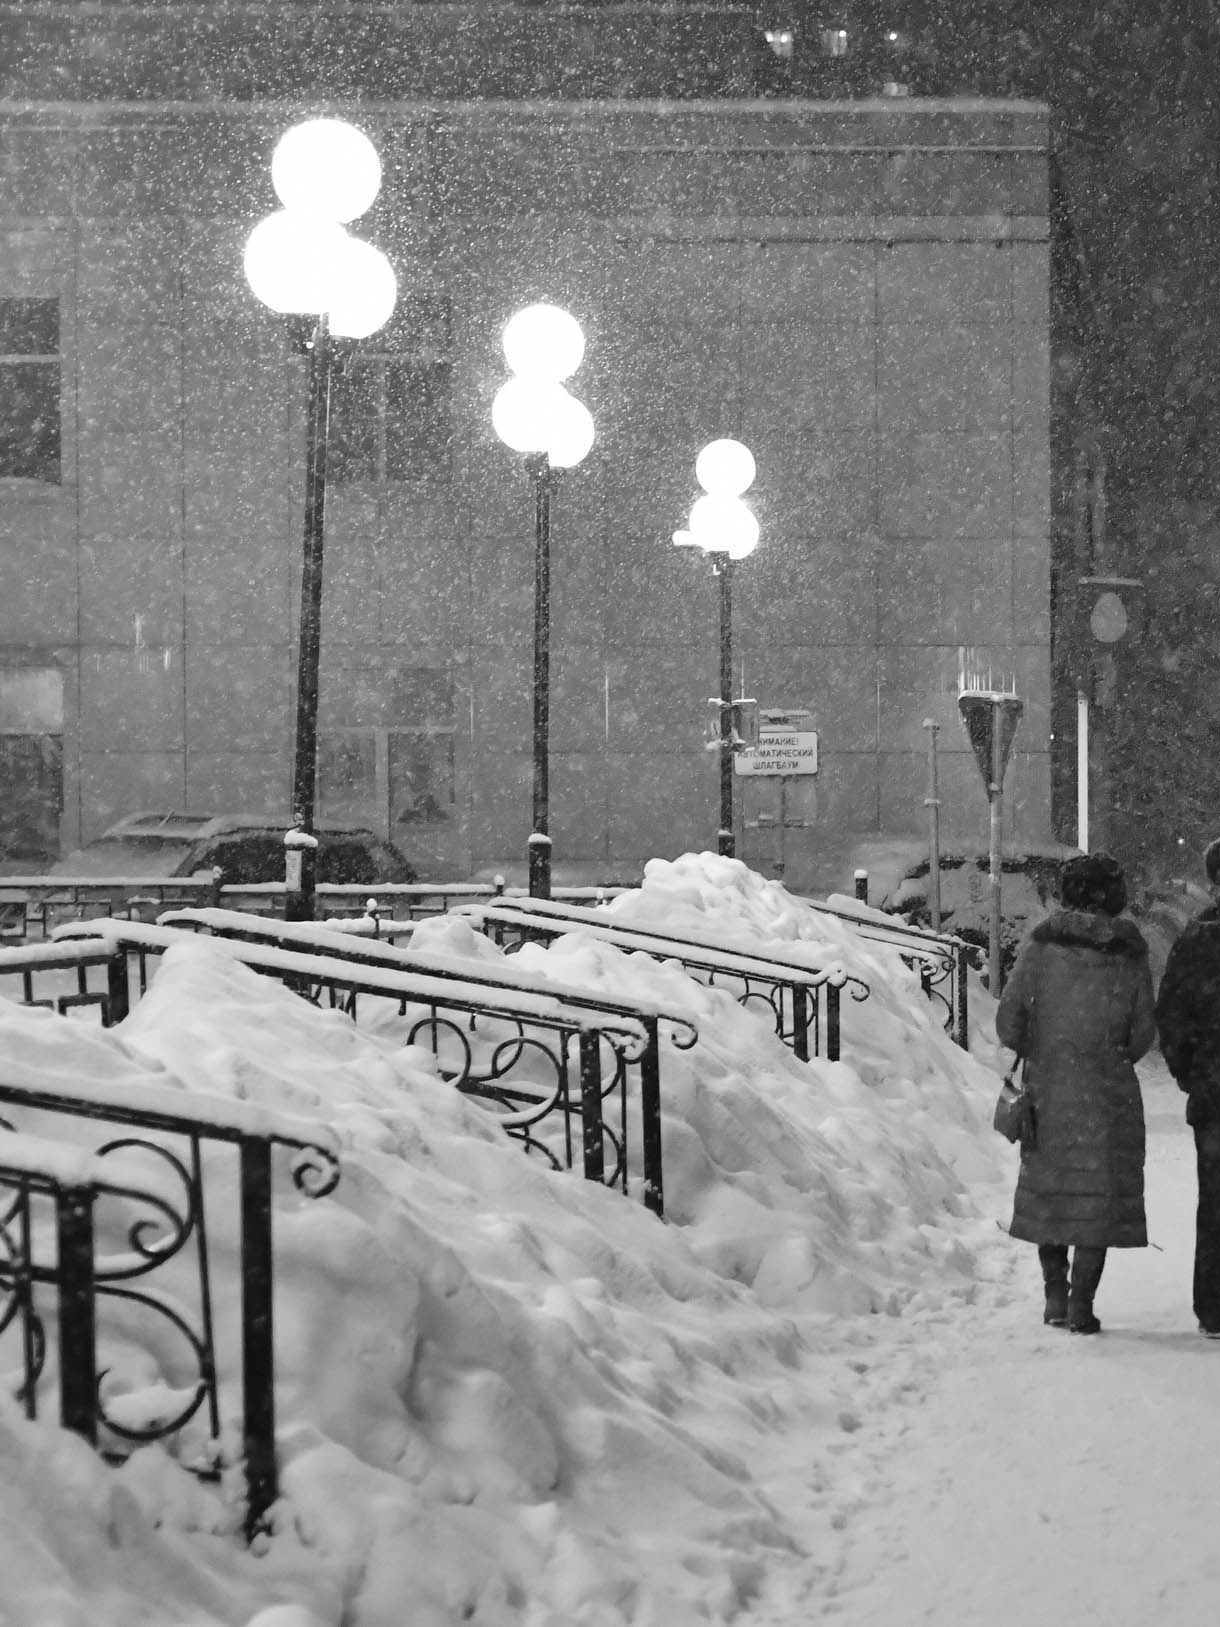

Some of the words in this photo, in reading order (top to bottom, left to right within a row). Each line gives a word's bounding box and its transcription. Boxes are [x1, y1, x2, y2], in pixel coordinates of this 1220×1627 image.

[759, 737, 799, 746] НИМАНИЕ!
[737, 748, 814, 759] АВТОМАТИЧЕСКИЙ
[752, 760, 799, 770] ШЛАГБАУМ
